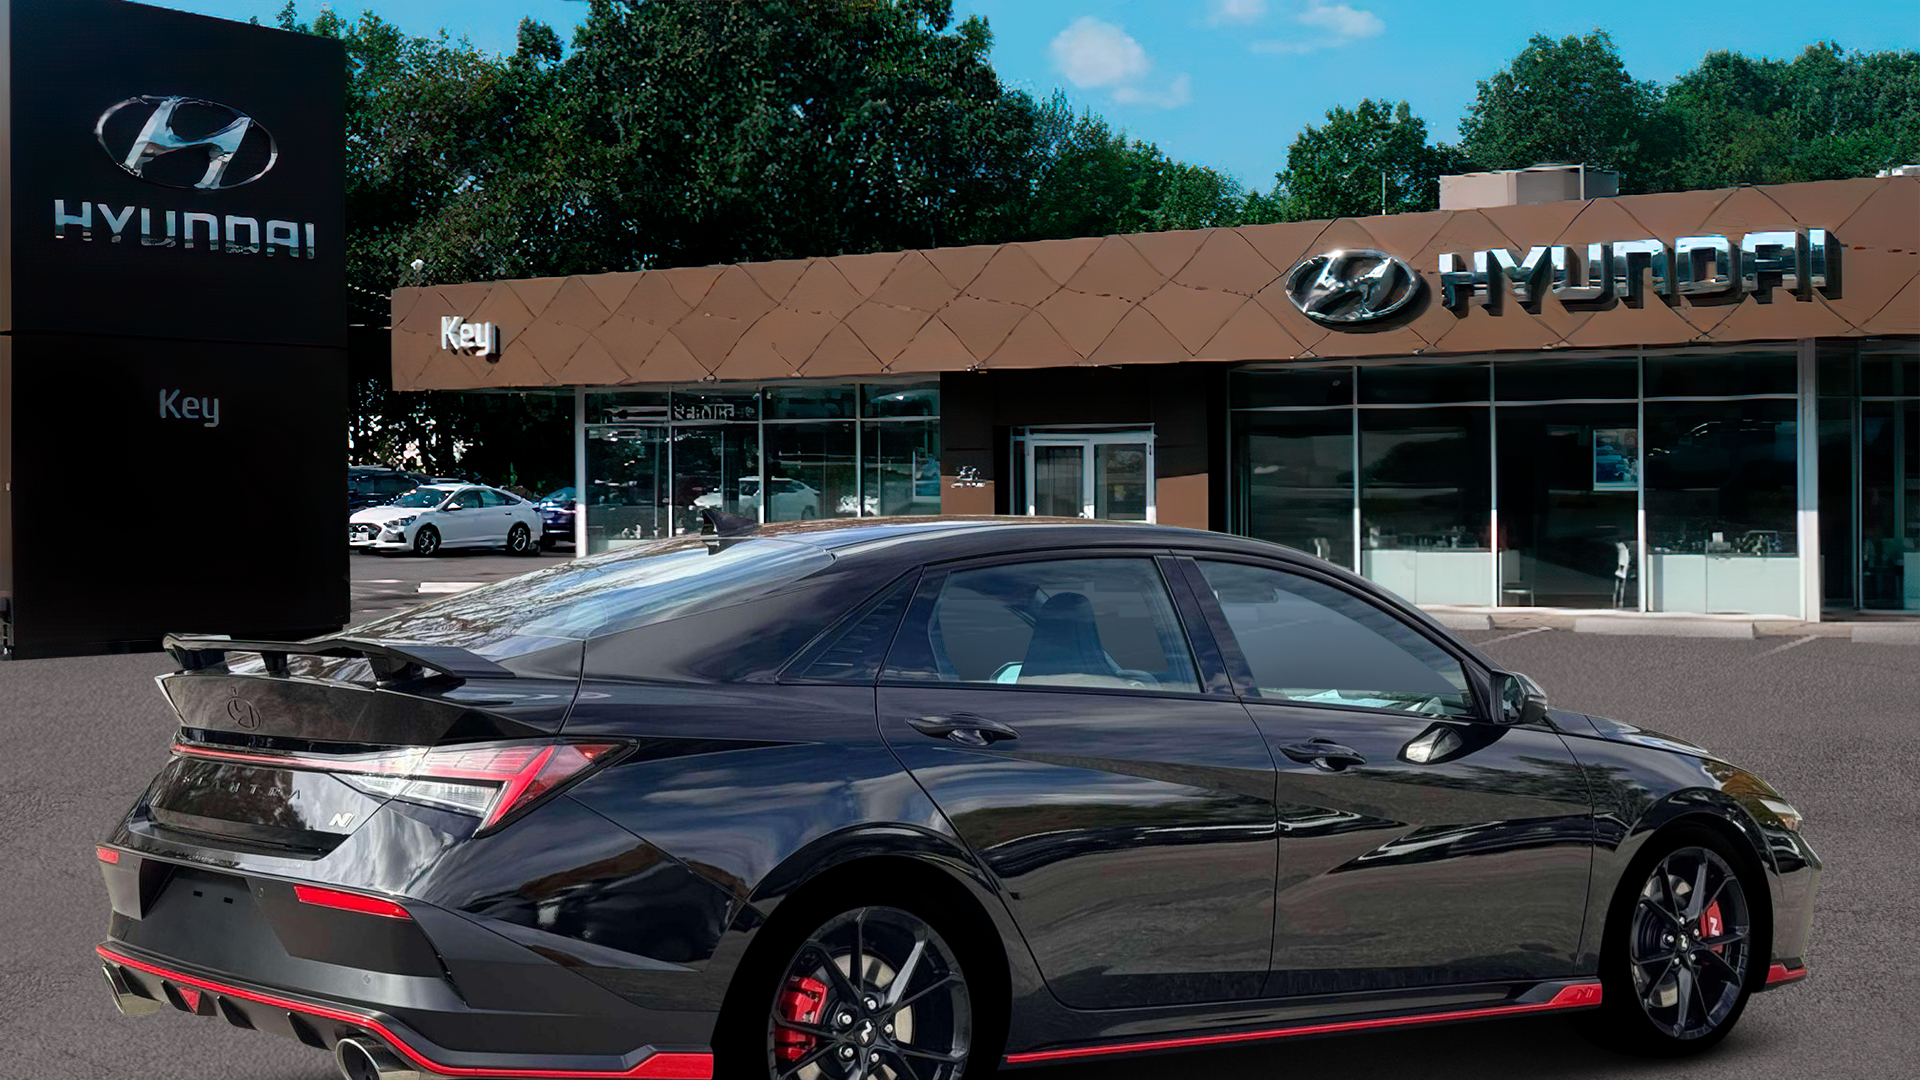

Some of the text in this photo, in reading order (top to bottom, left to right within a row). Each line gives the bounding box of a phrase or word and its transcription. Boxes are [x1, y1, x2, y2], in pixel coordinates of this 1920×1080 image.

[54, 199, 315, 260] HYUNDAI
[1438, 228, 1842, 312] HYUNDAI
[441, 315, 493, 357] Key
[159, 388, 219, 427] Key
